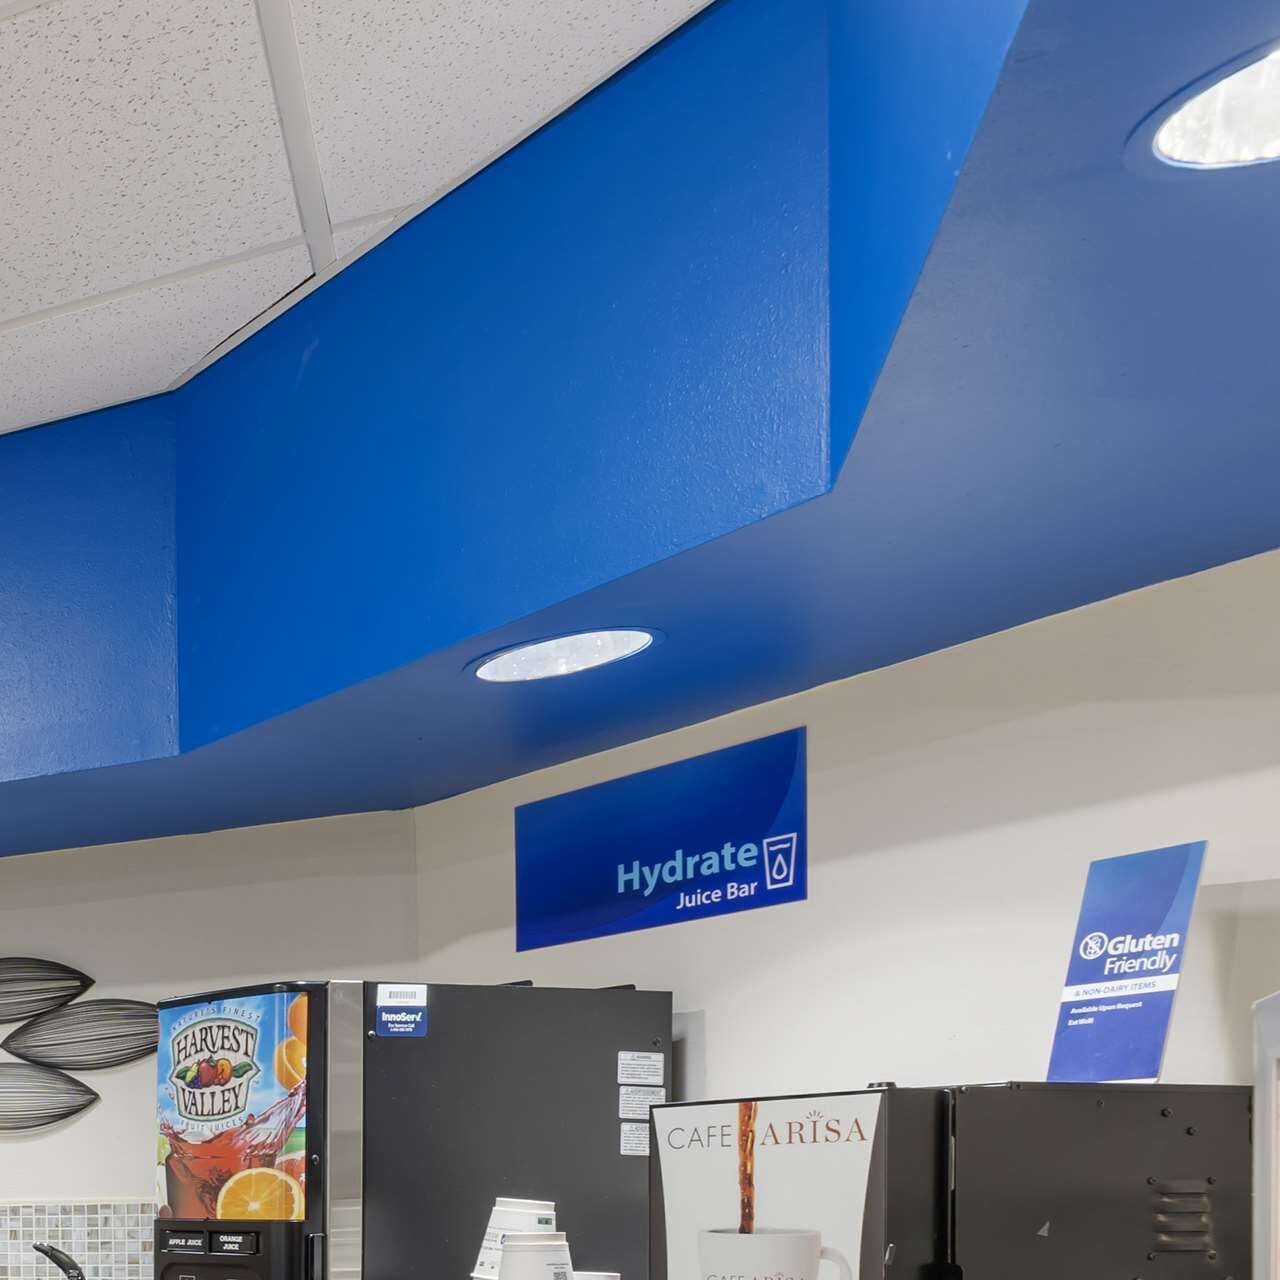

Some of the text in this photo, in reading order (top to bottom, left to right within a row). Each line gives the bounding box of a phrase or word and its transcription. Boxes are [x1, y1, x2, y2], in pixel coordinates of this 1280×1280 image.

[616, 841, 759, 897] Hydrate
[675, 880, 758, 910] Juice Bar
[1107, 932, 1181, 955] Gluten
[1103, 950, 1178, 976] Friendly
[1081, 984, 1129, 996] NON-DAIRY
[1130, 981, 1157, 992] ITEMS
[223, 1006, 261, 1022] FINEST
[176, 1024, 254, 1065] HARVEST
[180, 1082, 243, 1116] VALLEY
[180, 1116, 245, 1132] FRUIT JUICES
[667, 1124, 732, 1151] CAFE
[168, 1238, 186, 1246] APPLE
[219, 1235, 244, 1243] ORANGE
